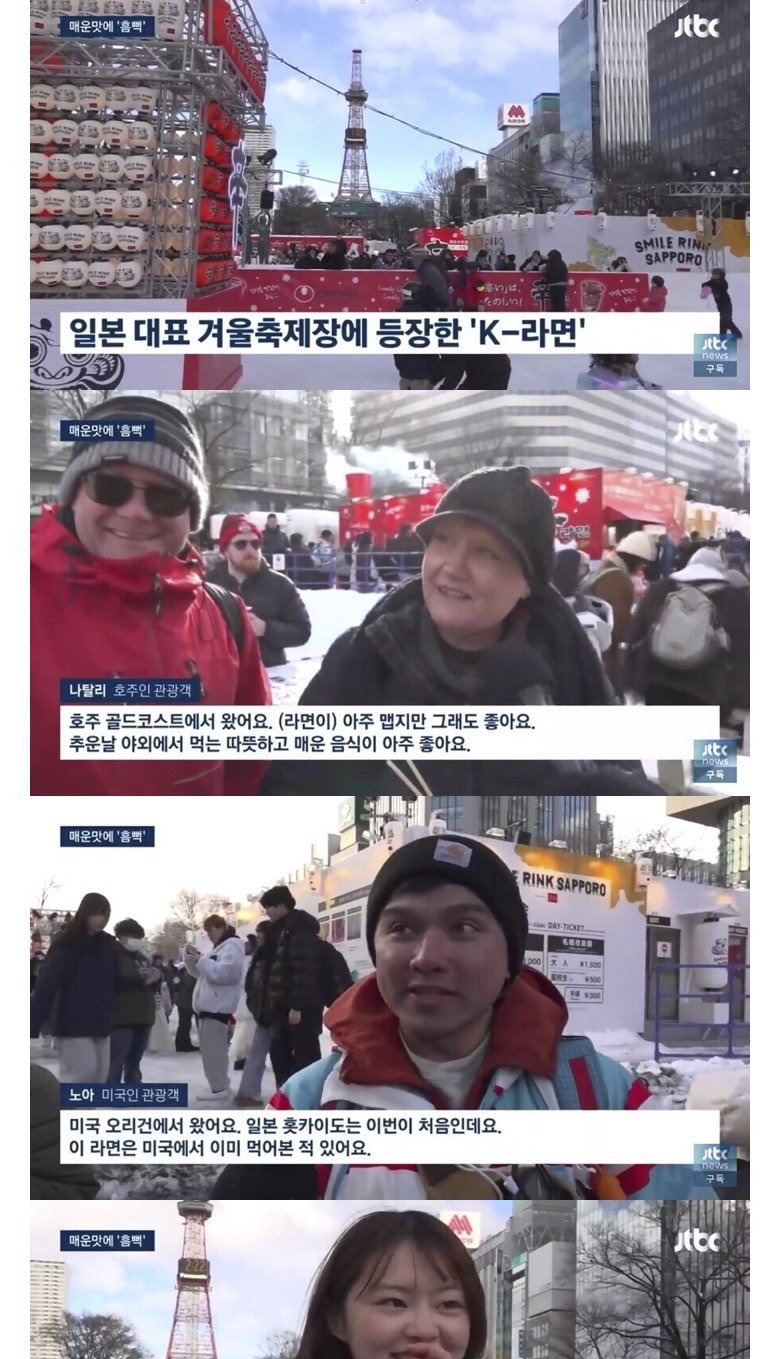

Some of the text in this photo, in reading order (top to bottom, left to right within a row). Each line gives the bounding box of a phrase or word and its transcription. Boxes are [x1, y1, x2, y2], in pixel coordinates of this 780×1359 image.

[634, 237, 673, 253] SMILE
[645, 251, 702, 266] SAPPORO
[523, 871, 606, 897] RINK SAPPORO
[548, 922, 585, 932] DAY-TICKET
